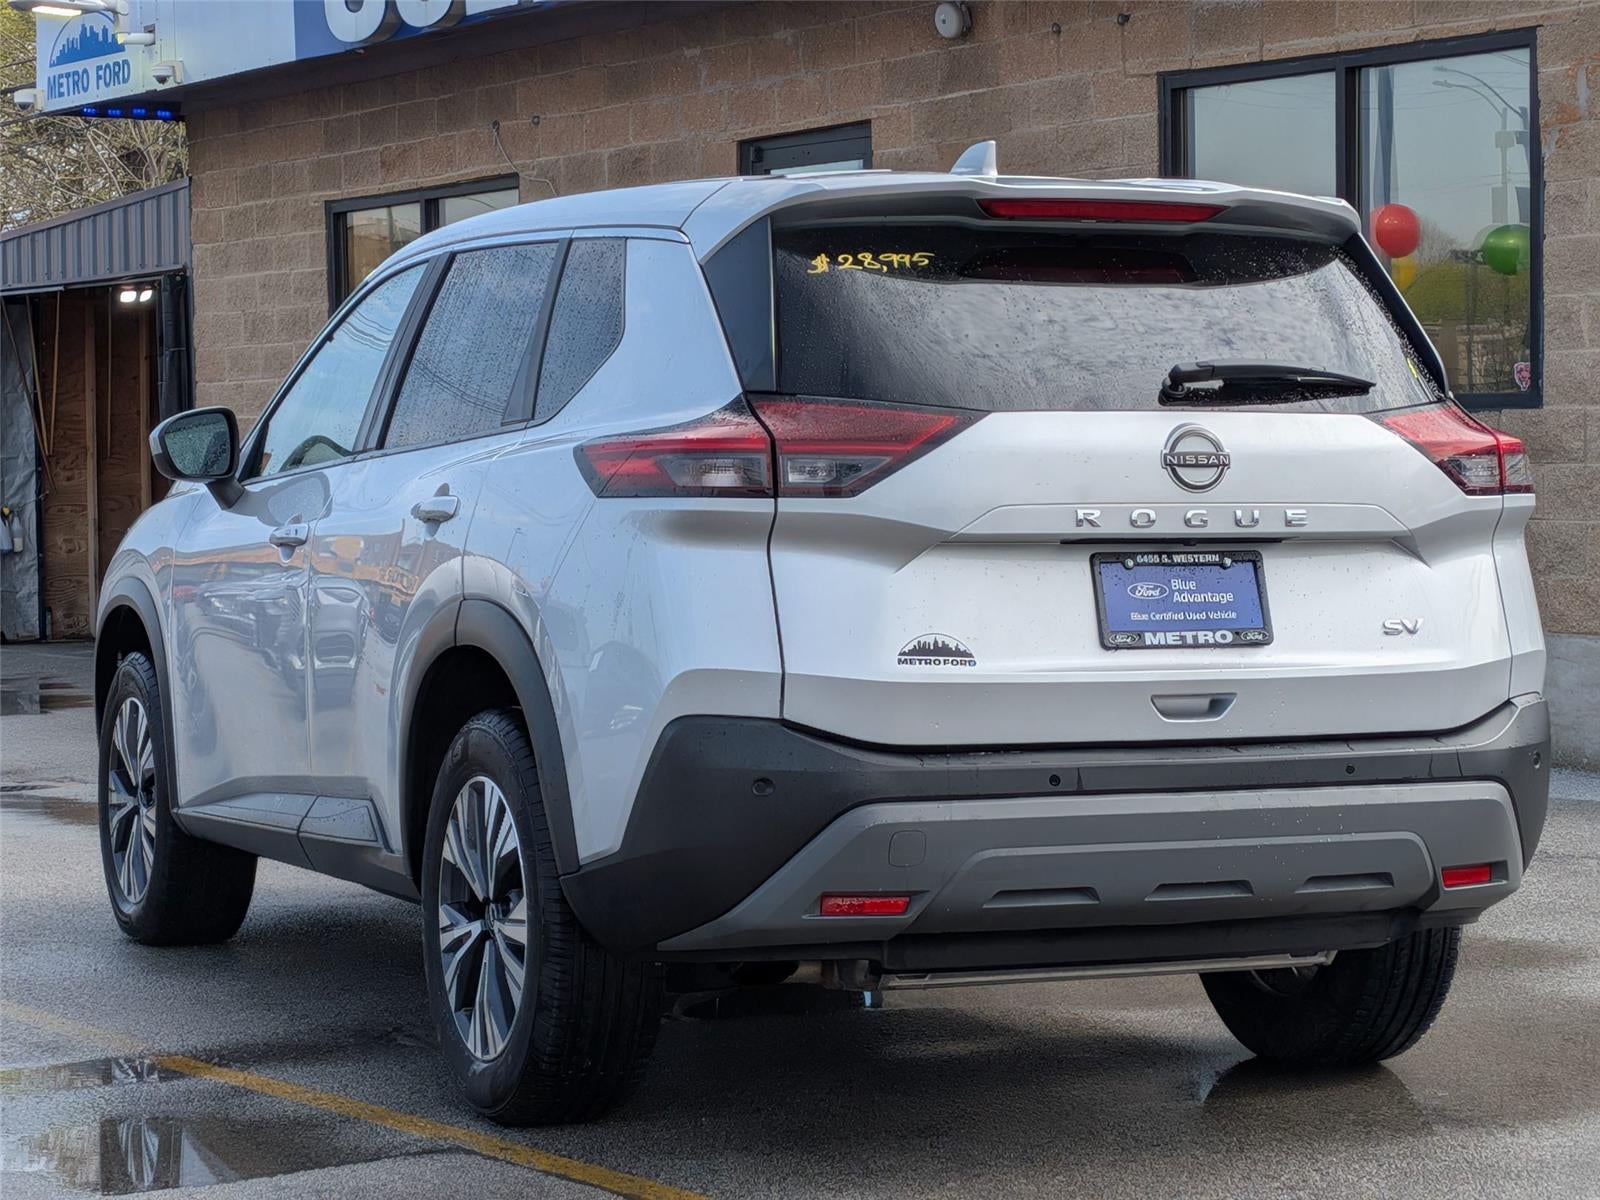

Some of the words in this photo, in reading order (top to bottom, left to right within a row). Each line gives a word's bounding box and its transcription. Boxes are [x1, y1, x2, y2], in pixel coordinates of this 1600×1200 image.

[47, 67, 90, 100] METRO
[95, 59, 131, 90] FORD
[1165, 454, 1230, 466] NISSAN
[1075, 508, 1309, 529] ROGUE
[1172, 552, 1220, 564] WESTERN
[1170, 578, 1197, 590] Blue
[1173, 591, 1234, 604] Advantage
[1150, 611, 1184, 621] Certified
[1185, 611, 1206, 620] Used
[1207, 610, 1237, 620] Vehicle
[1382, 617, 1424, 636] SV
[1144, 629, 1234, 646] METRO
[897, 657, 941, 666] METRO
[943, 658, 977, 667] FORD
